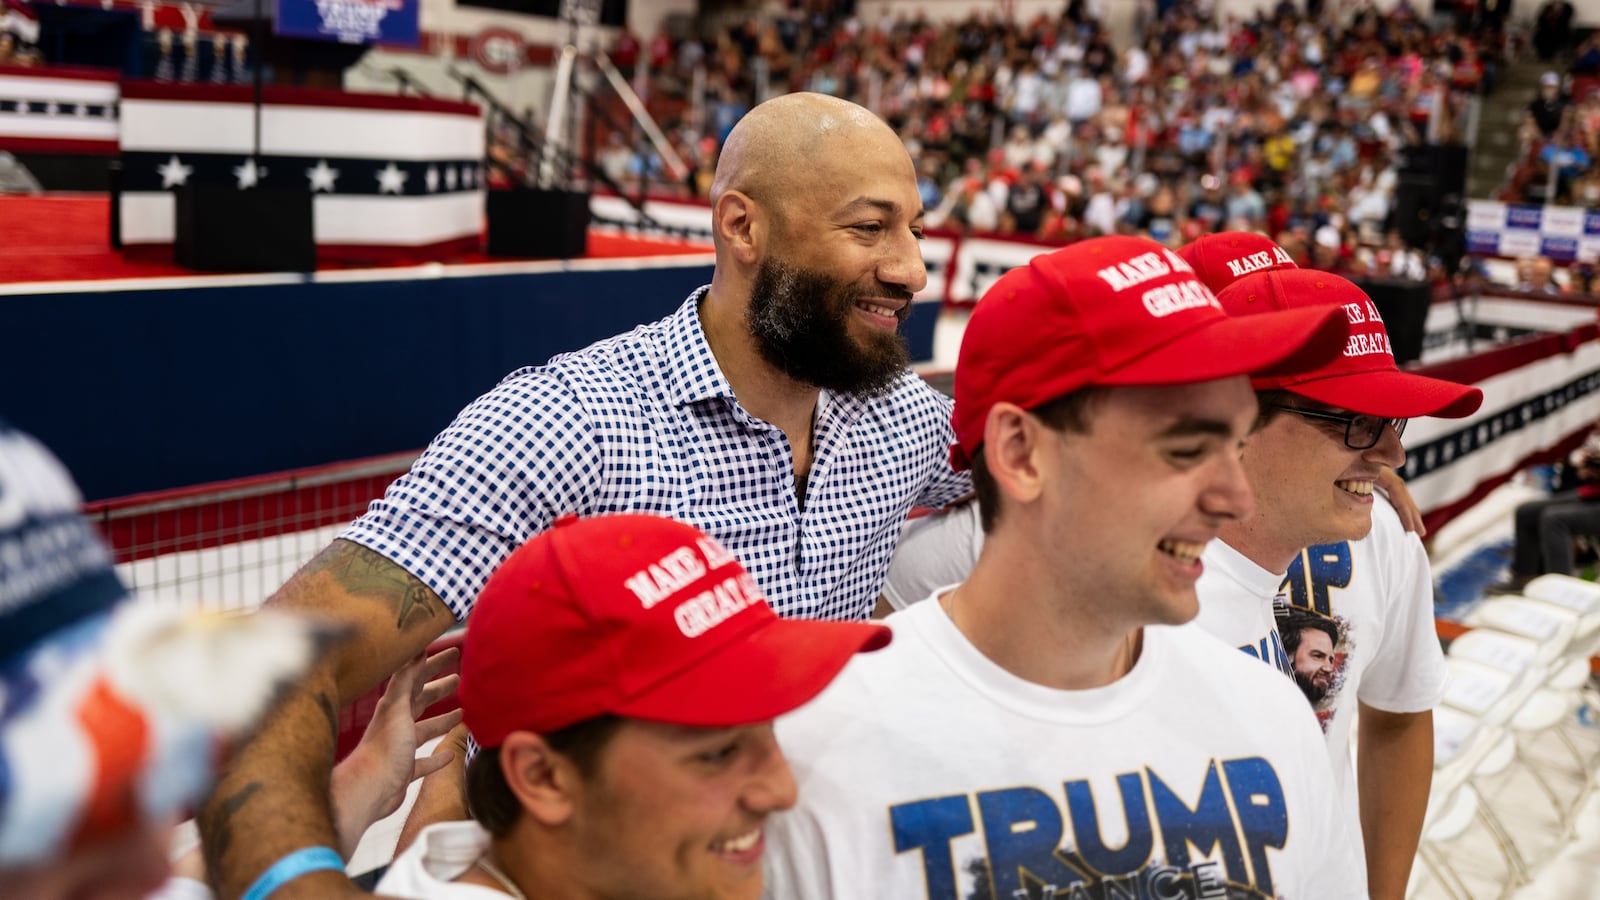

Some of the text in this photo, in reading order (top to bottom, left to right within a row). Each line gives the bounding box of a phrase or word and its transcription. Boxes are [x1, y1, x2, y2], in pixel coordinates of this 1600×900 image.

[1097, 252, 1171, 293] MAKE
[1226, 250, 1273, 277] MAKE
[1142, 280, 1209, 318] GREAT
[1341, 302, 1365, 324] KE
[1343, 332, 1384, 357] GREAT
[624, 546, 707, 610] MAKE
[674, 577, 749, 638] GREAT
[888, 756, 1289, 900] TRUMP
